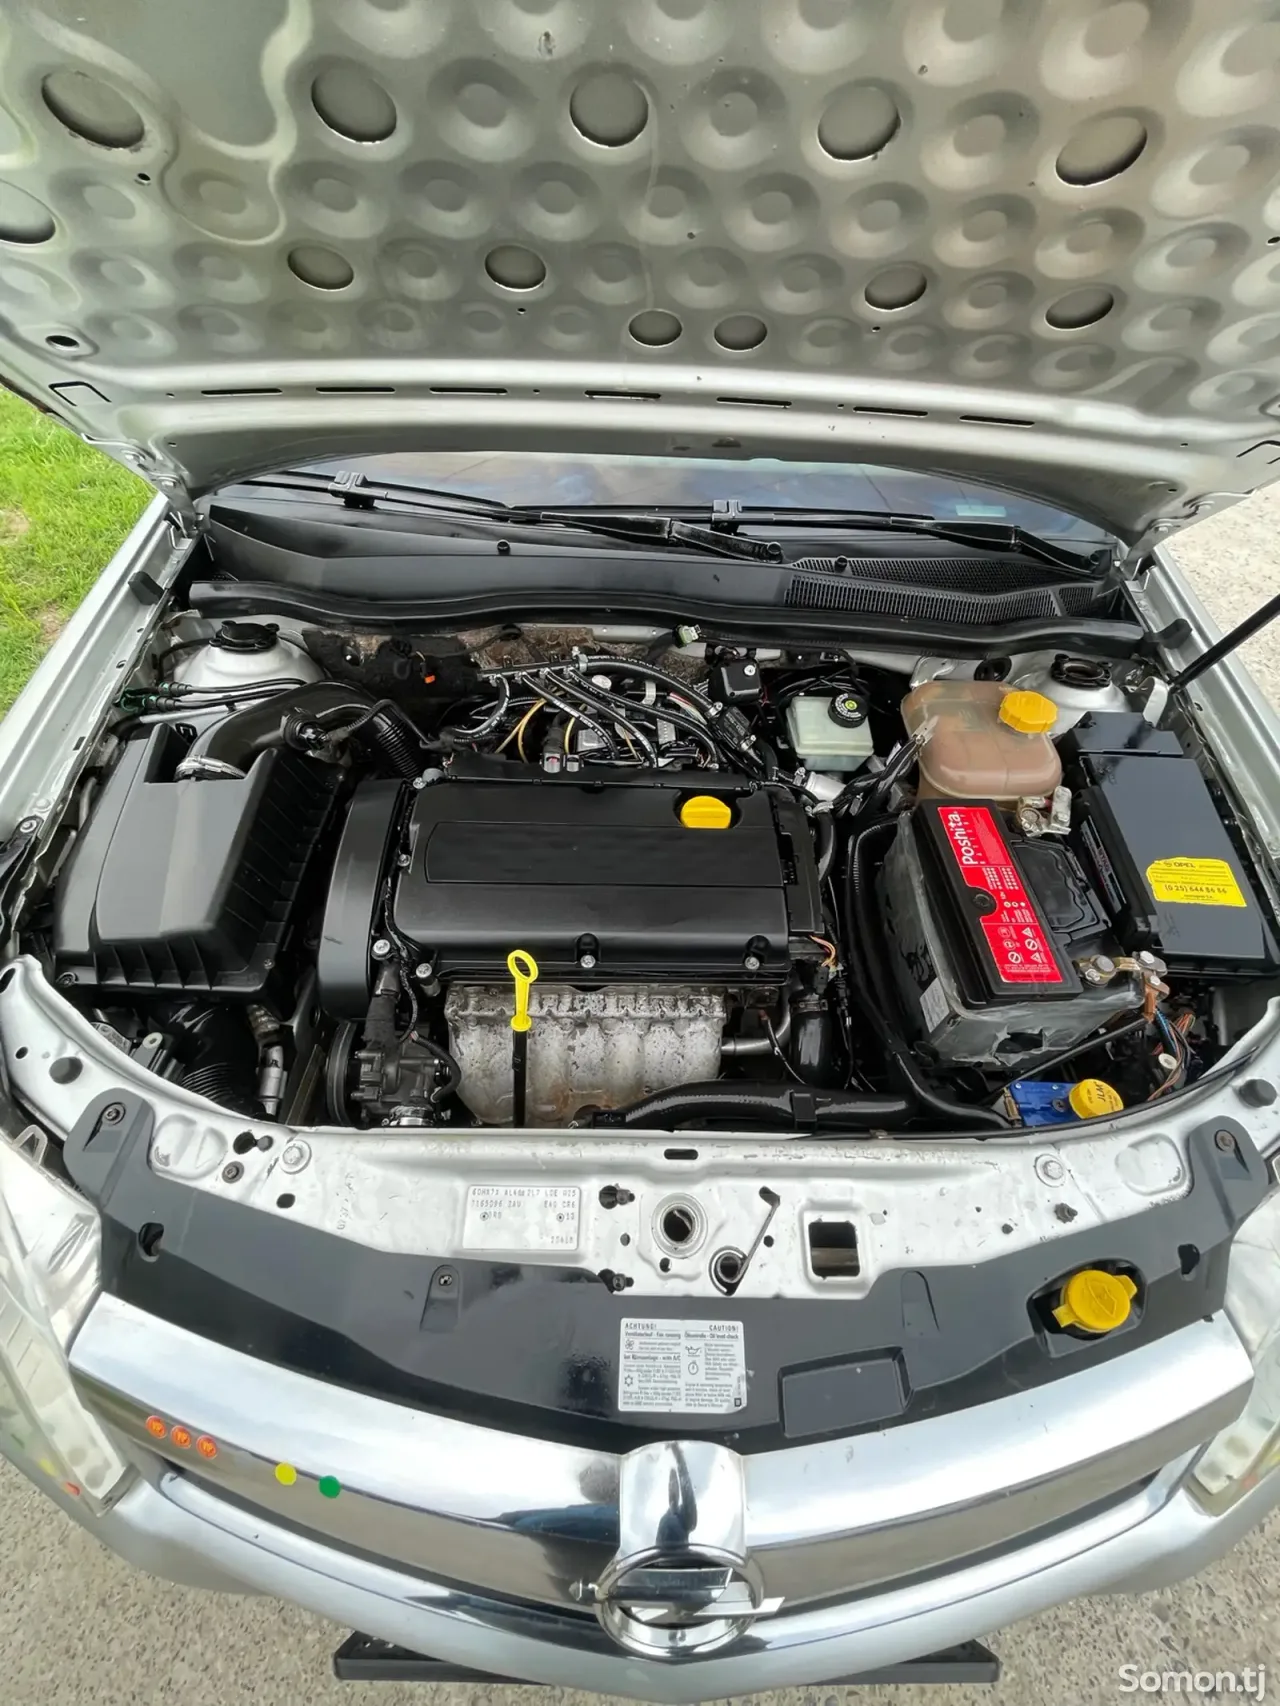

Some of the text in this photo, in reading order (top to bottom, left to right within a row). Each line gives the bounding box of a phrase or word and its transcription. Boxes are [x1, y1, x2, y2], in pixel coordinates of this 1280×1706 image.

[948, 813, 978, 864] Poshita
[625, 1322, 657, 1330] ACHTUNG!
[709, 1324, 739, 1332] CAUTION!
